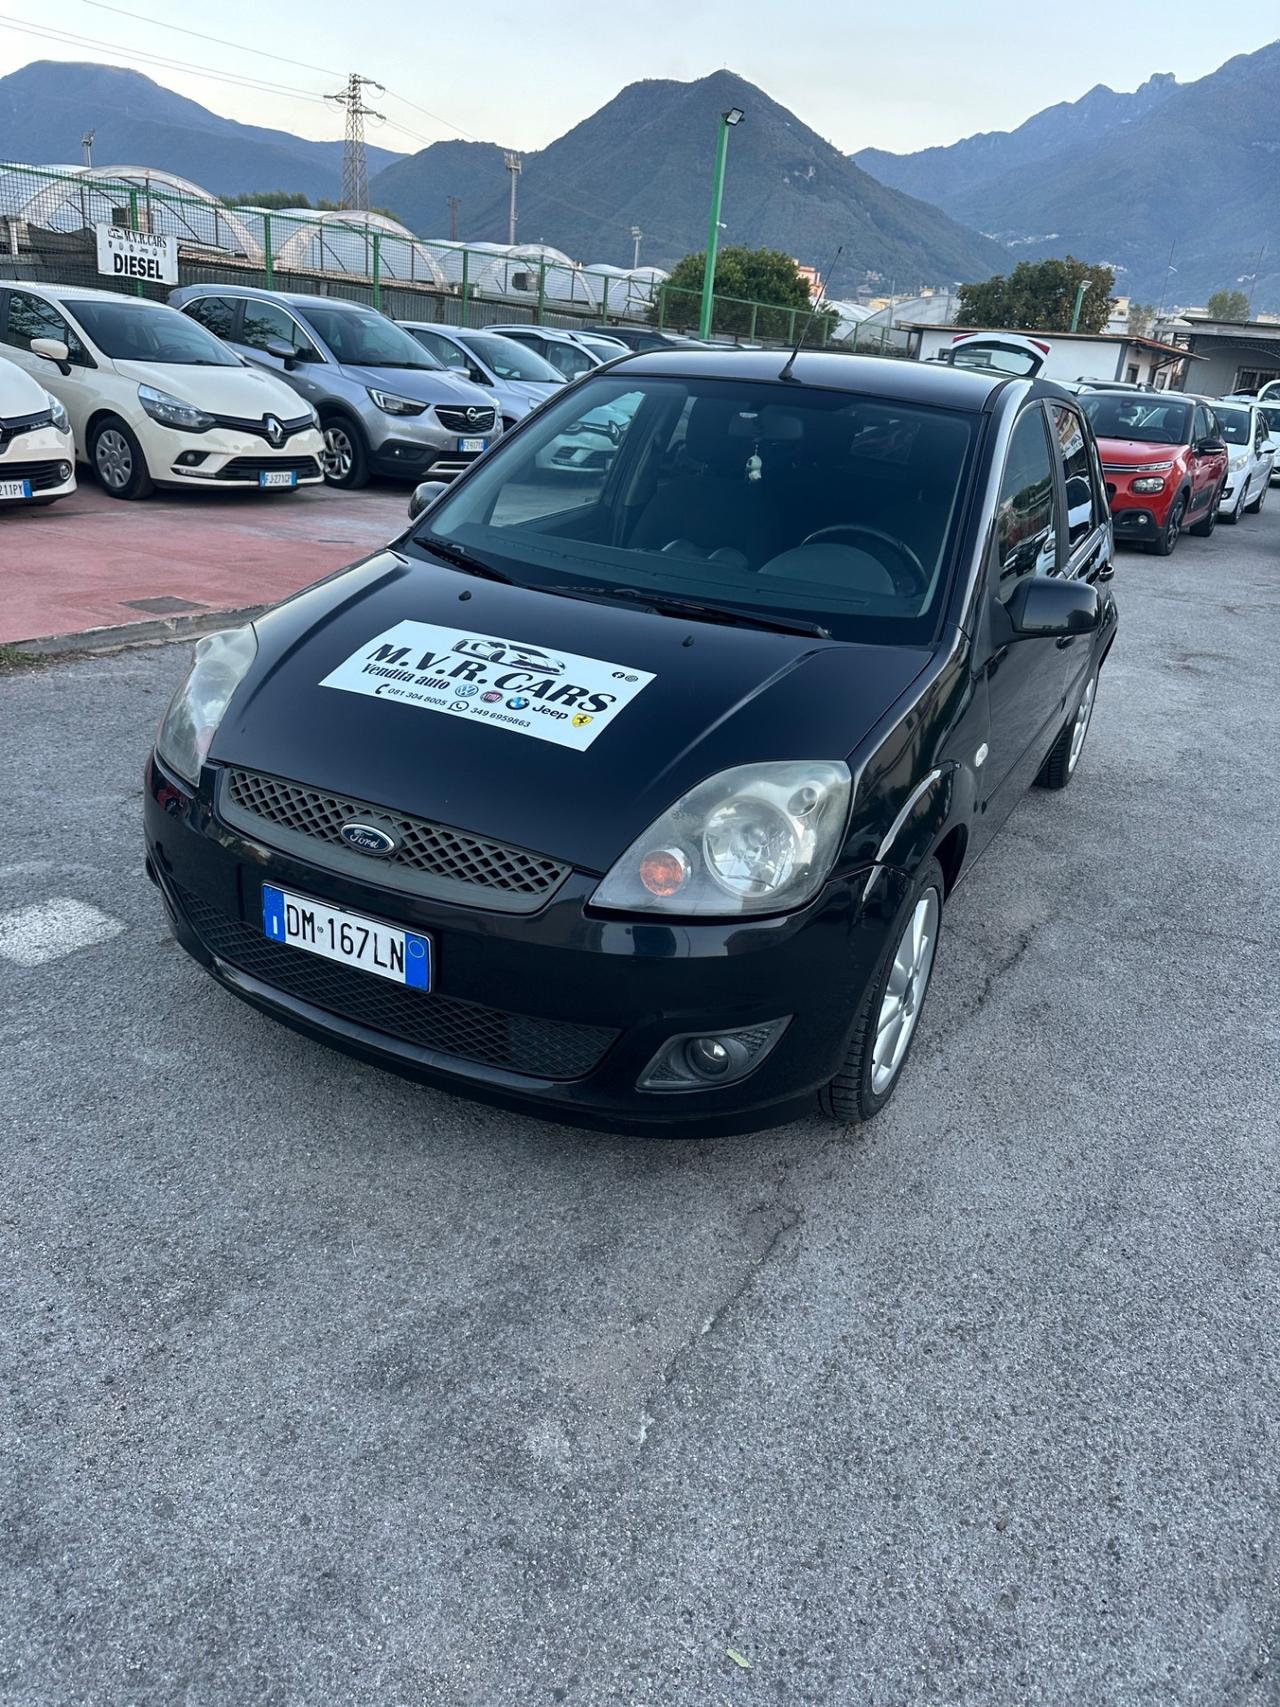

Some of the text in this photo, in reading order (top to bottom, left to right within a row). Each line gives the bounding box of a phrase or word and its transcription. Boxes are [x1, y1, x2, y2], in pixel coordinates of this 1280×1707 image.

[113, 253, 163, 280] DIESEL
[361, 663, 451, 690] Vendita auto
[387, 688, 448, 706] 081 304 8005
[470, 707, 531, 728] 349 6959863
[532, 705, 569, 720] Jeep
[349, 829, 380, 849] Ford
